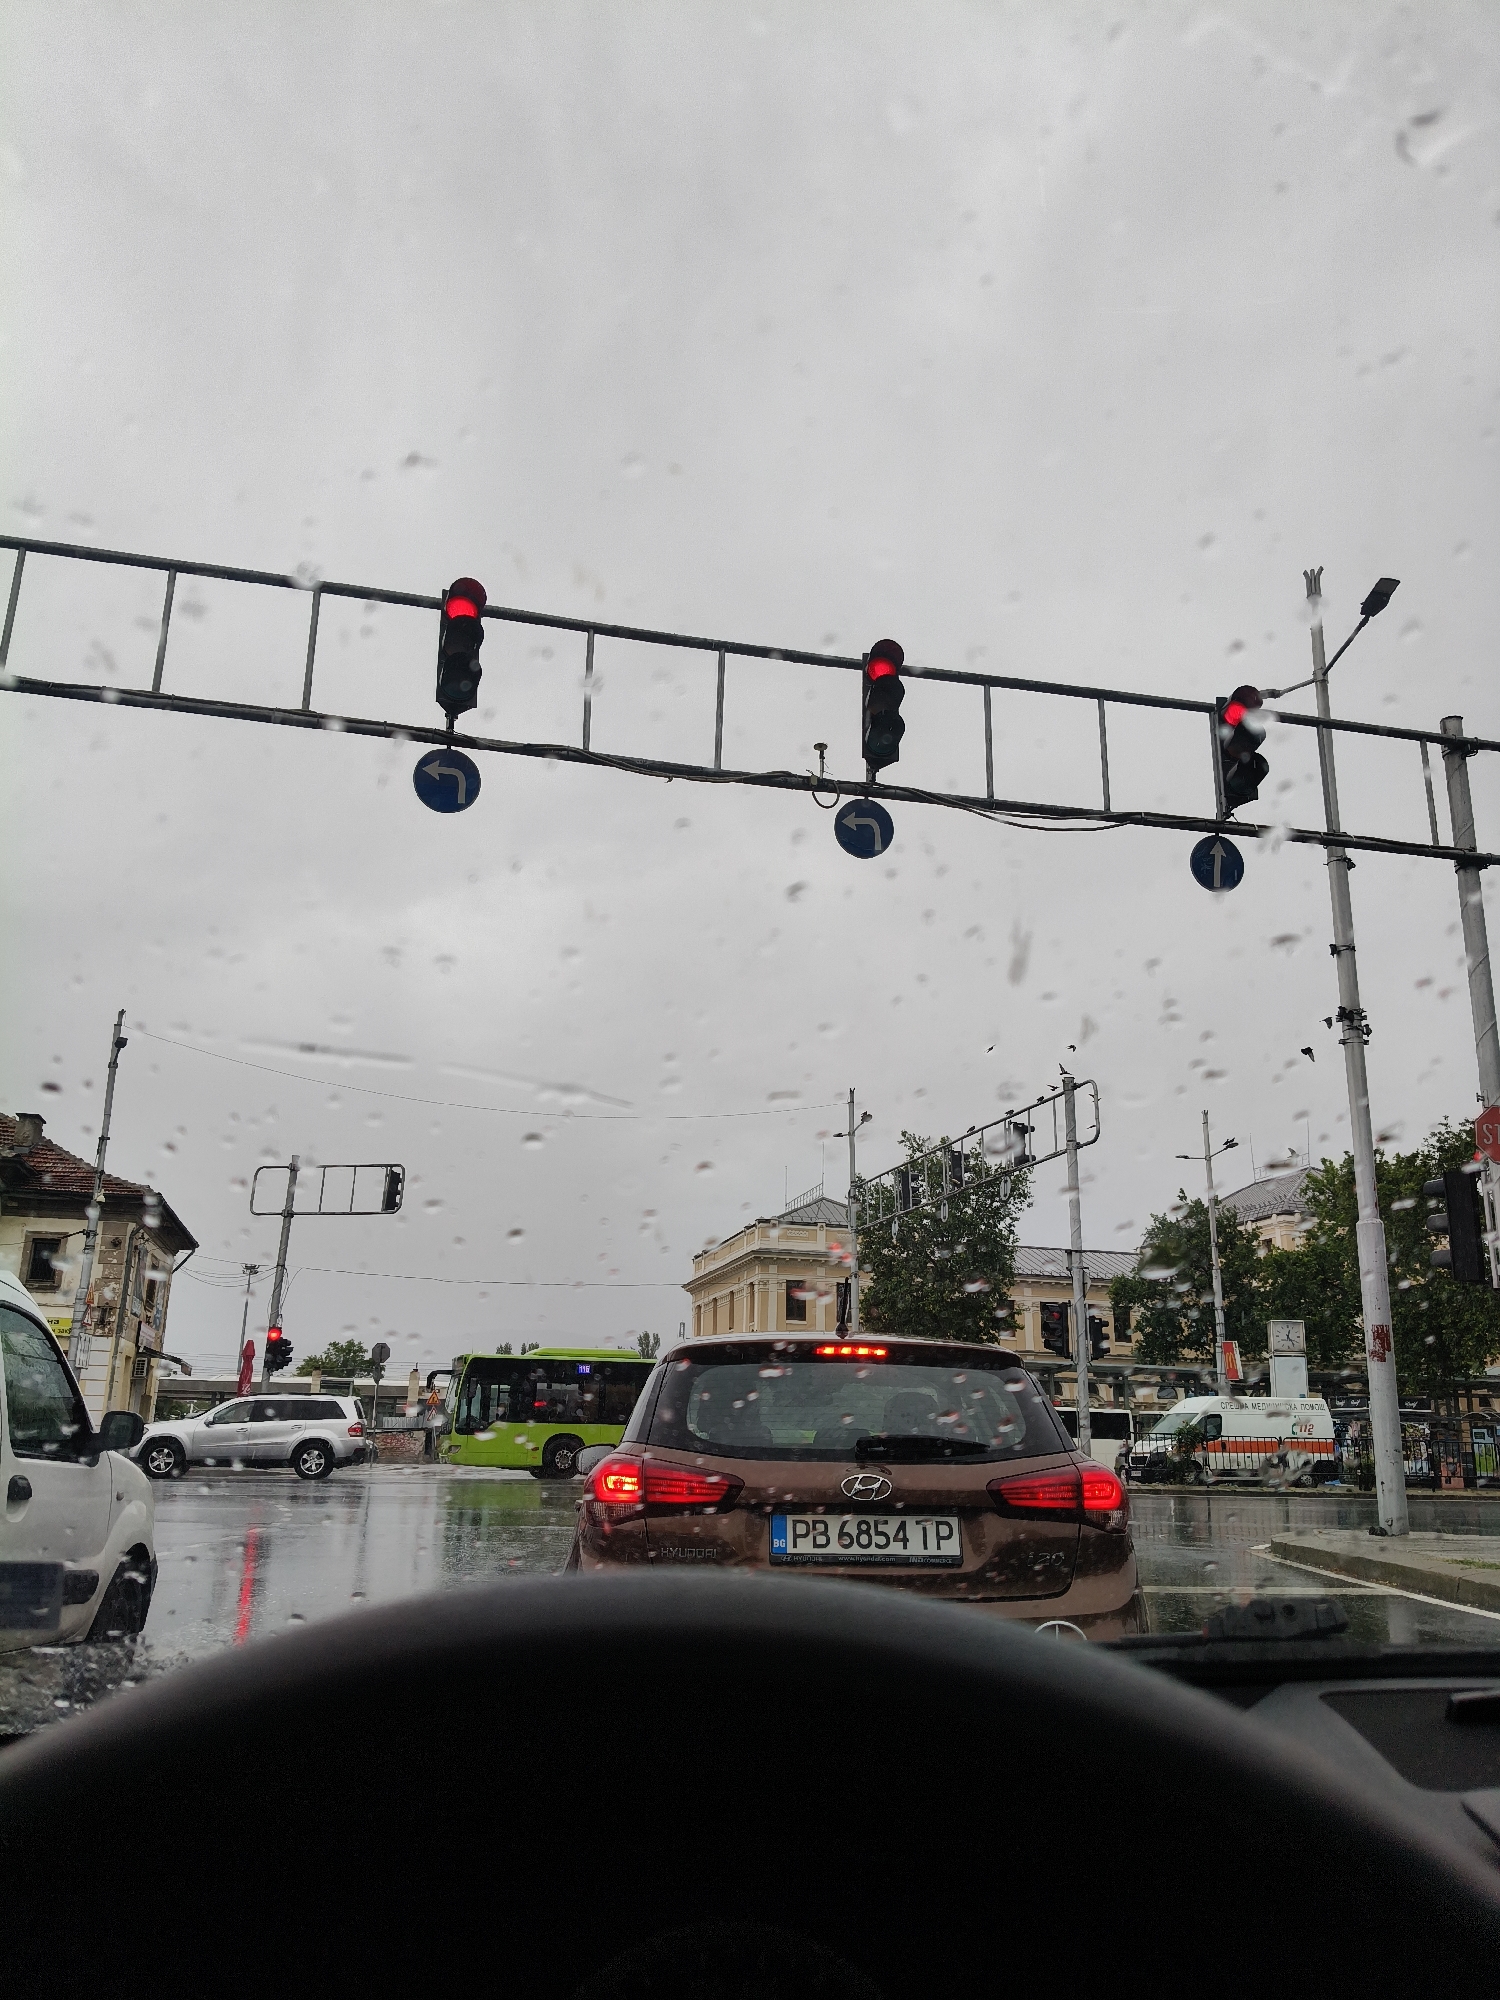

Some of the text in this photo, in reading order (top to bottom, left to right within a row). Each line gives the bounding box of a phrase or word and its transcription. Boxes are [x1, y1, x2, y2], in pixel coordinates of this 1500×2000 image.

[1220, 1401, 1249, 1410] СПЕША
[1299, 1423, 1315, 1433] 112
[791, 1519, 954, 1551] PB 6854 TP
[772, 1538, 786, 1548] BG
[660, 1547, 717, 1559] HYUNDAI
